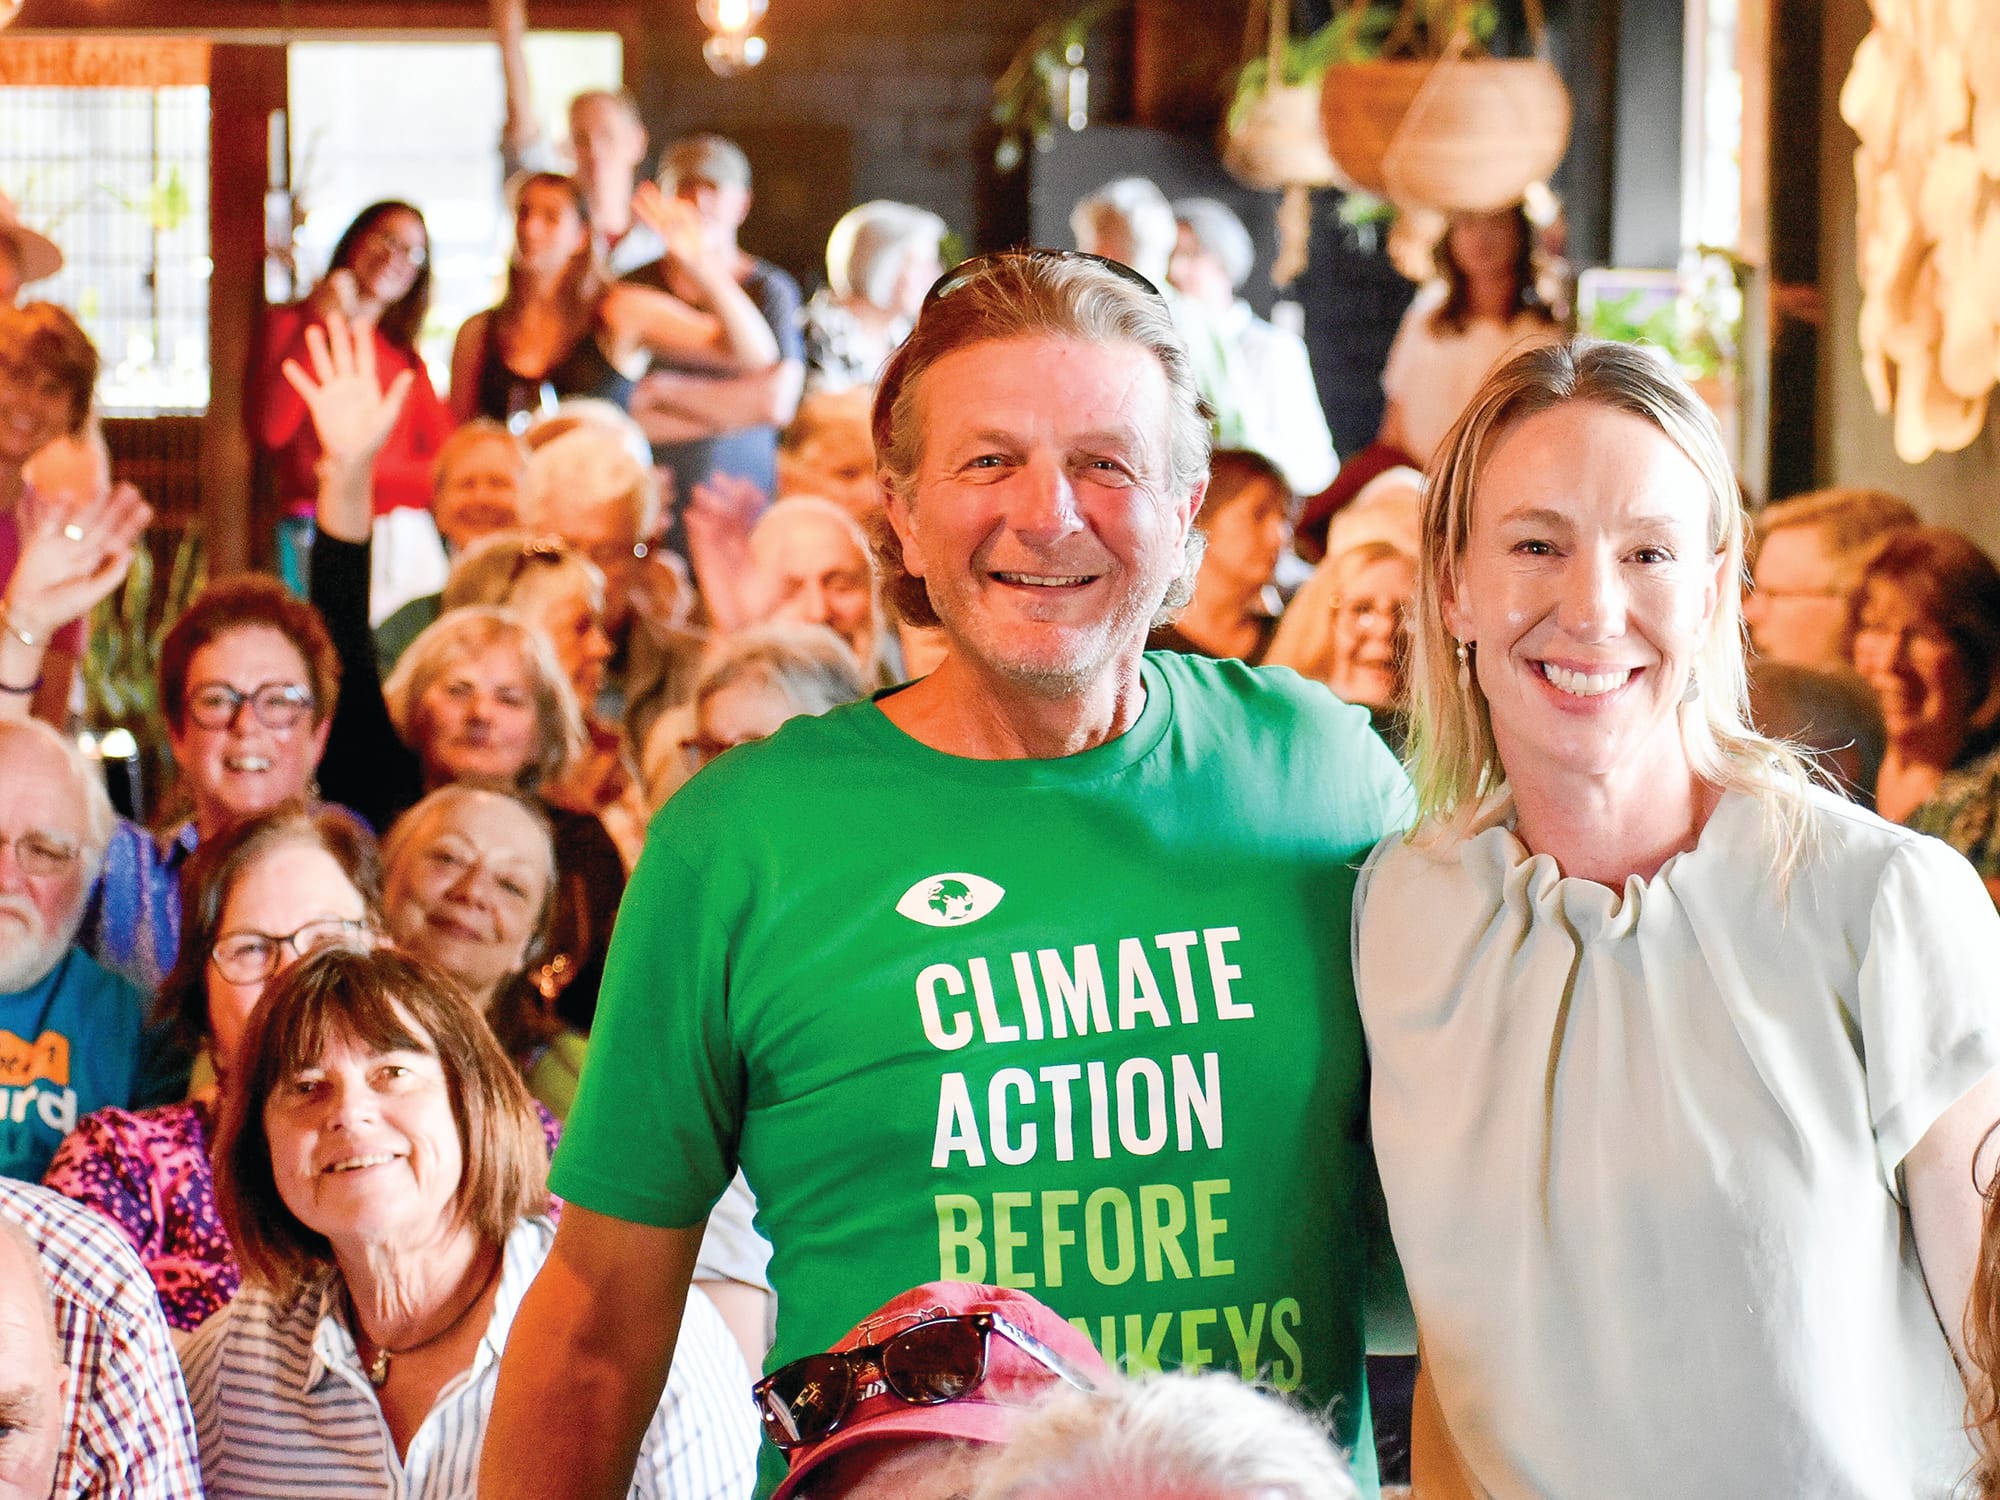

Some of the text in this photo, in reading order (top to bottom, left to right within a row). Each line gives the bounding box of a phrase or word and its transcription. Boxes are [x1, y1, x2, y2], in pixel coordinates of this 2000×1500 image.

[915, 926, 1255, 1051] CLIMATE
[931, 1052, 1223, 1168] ACTION
[935, 1179, 1235, 1288] BEFORE
[1068, 1297, 1303, 1392] NKEYS
